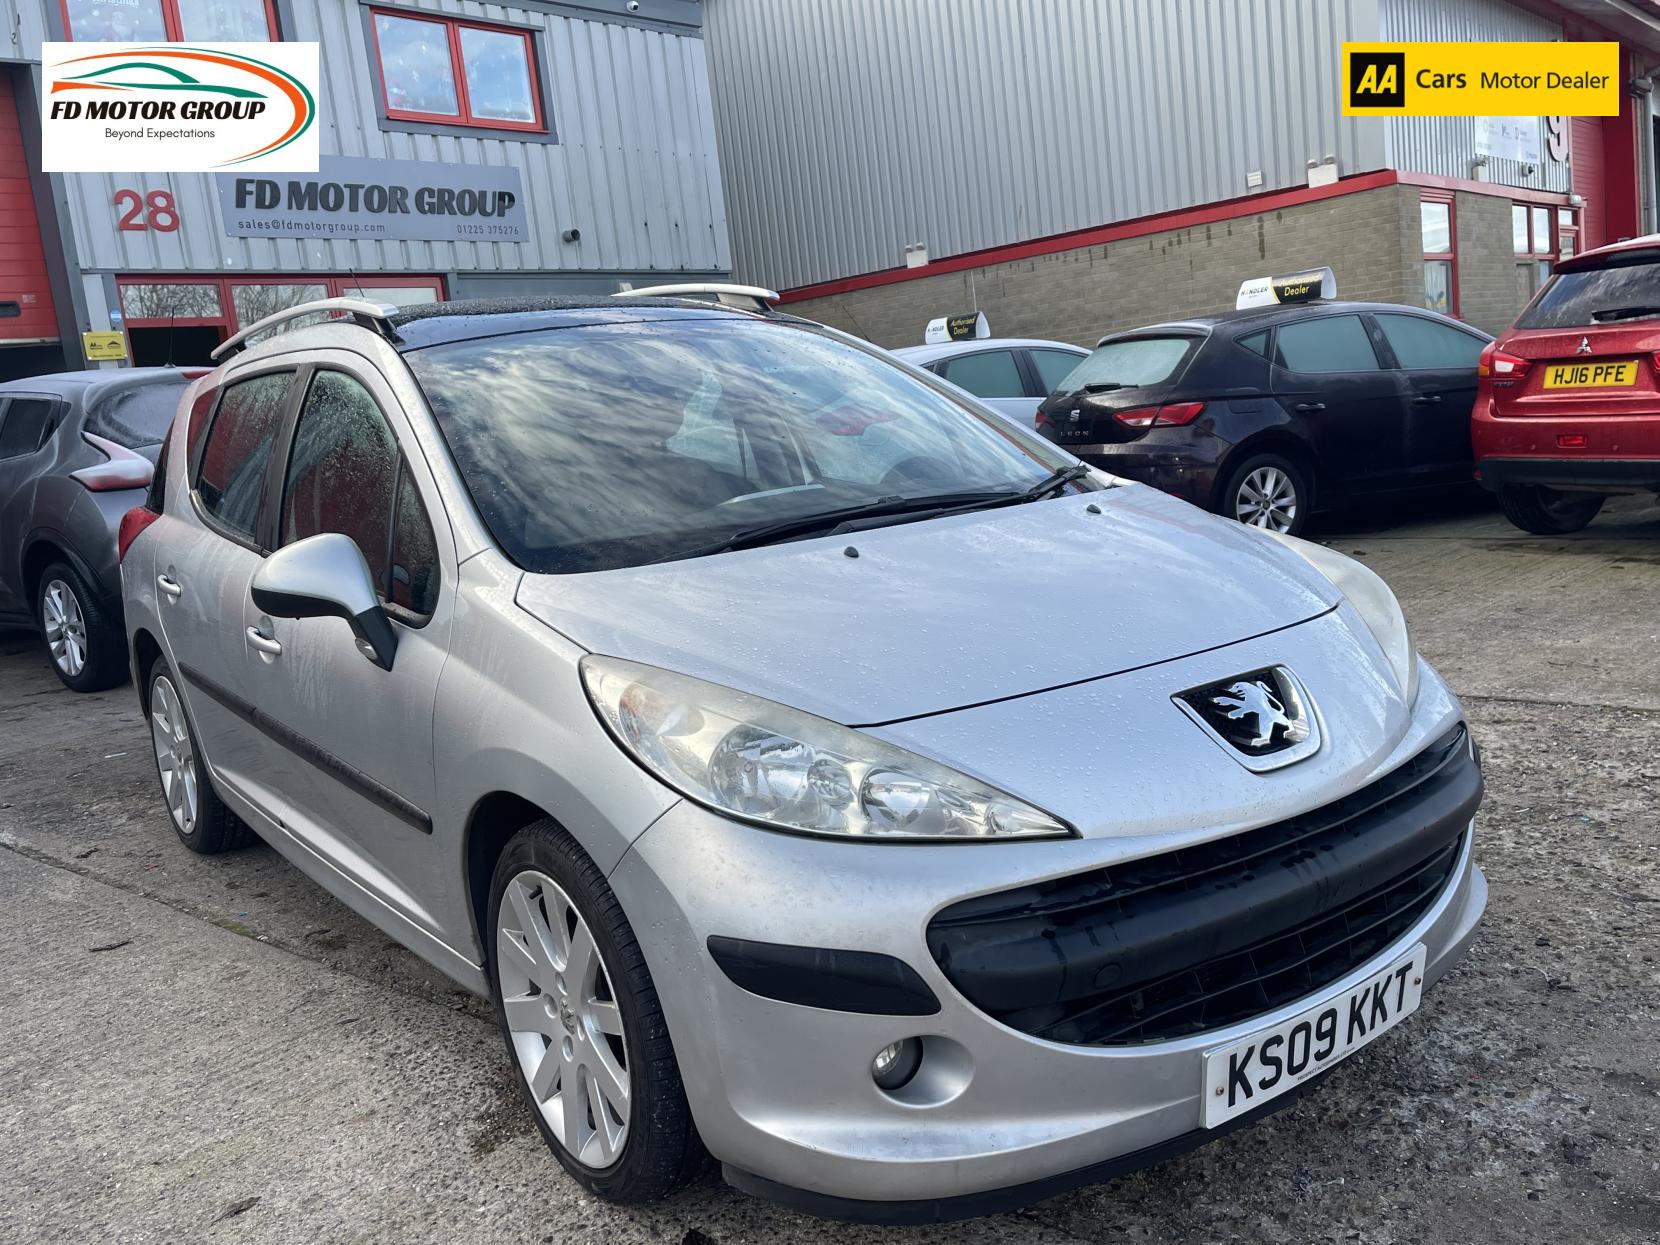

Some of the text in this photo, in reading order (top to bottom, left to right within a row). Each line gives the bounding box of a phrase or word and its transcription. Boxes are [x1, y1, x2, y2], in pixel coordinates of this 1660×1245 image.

[235, 178, 516, 218] FD MOTOR GROUP
[114, 188, 179, 232] 28
[238, 219, 386, 233] sales@fdmotorgroup.com
[457, 224, 484, 234] 01225
[1284, 285, 1310, 297] Dealer
[953, 326, 969, 335] Dealer
[1553, 365, 1627, 385] HJ16 PFE
[1228, 960, 1414, 1108] KS09 KKT
